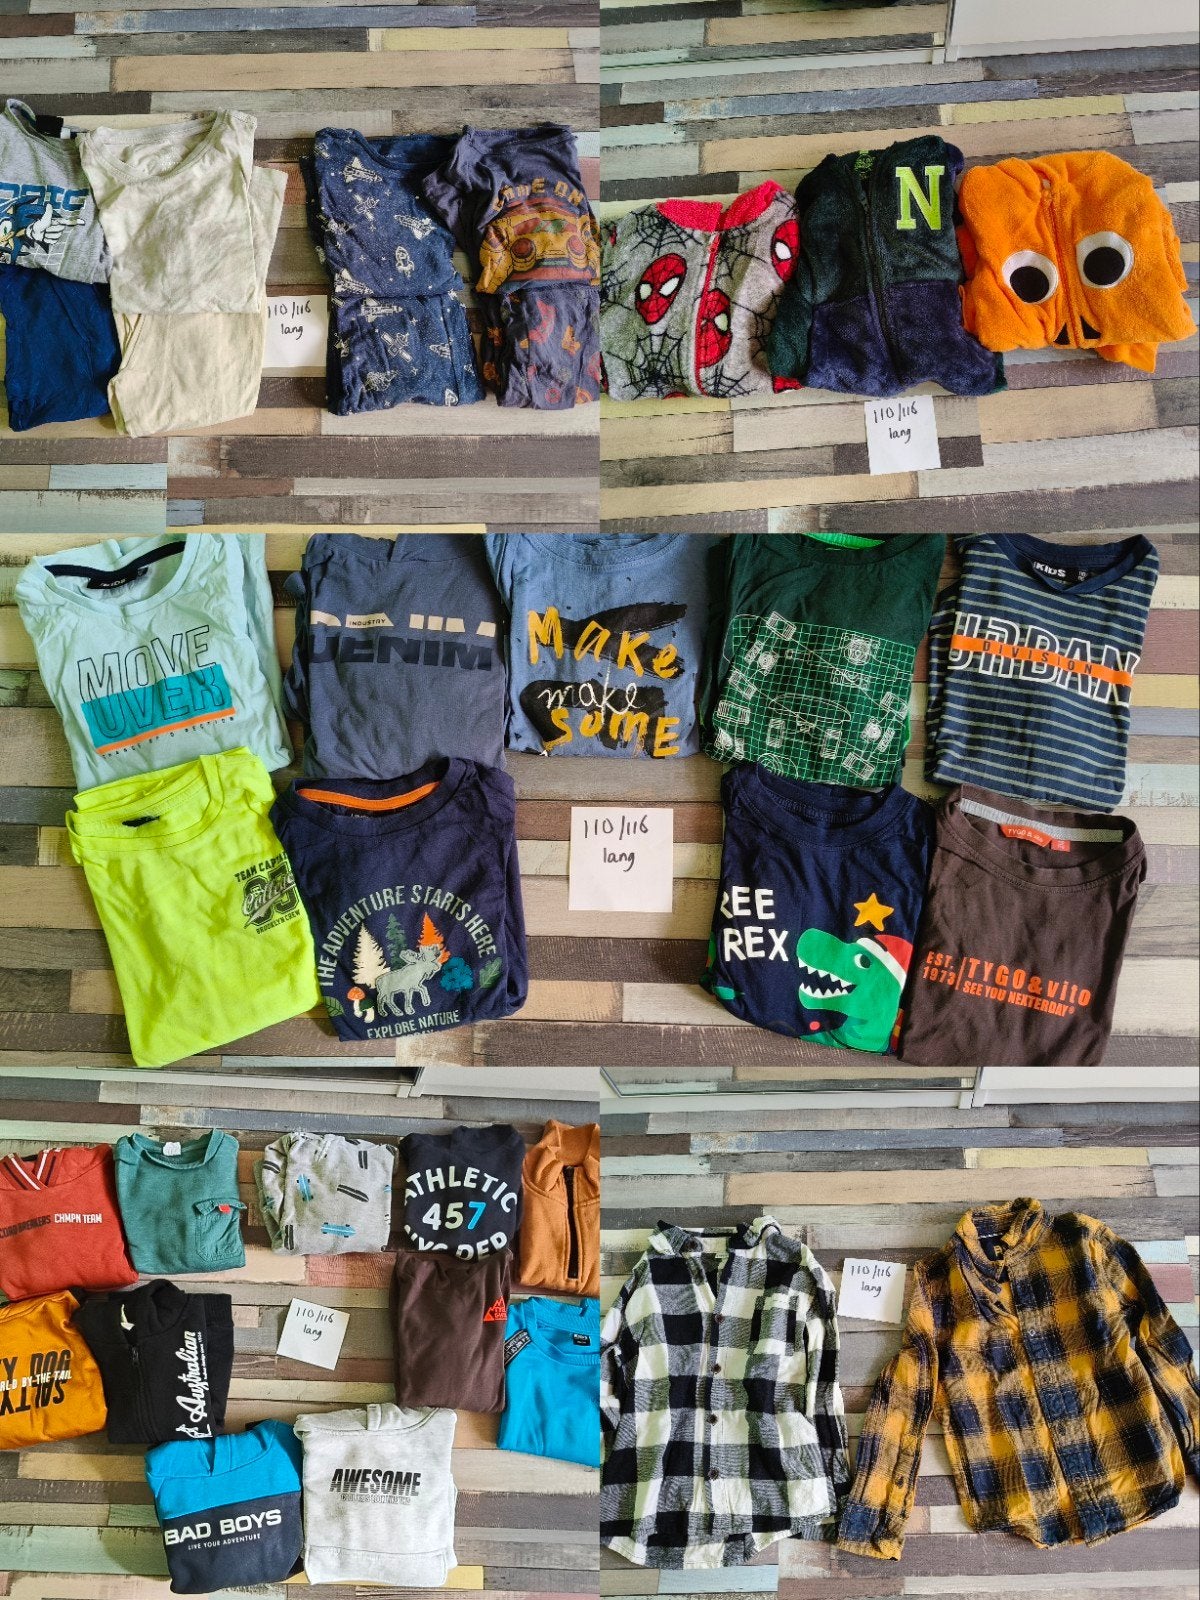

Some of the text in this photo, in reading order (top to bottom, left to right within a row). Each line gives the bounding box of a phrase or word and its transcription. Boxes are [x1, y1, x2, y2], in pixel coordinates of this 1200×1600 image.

[896, 165, 945, 230] N
[268, 300, 311, 318] 110/116
[281, 324, 303, 340] lang
[874, 401, 917, 423] 110/116
[889, 428, 911, 444] lang
[349, 618, 386, 626] INDUSTRY
[77, 625, 216, 703] MOVE
[983, 640, 1092, 675] DIVISION
[584, 815, 648, 840] 110/116
[603, 847, 635, 872] lang
[234, 865, 257, 882] TEAM
[410, 884, 472, 921] STARTS
[322, 885, 406, 956] ADVENTURE
[464, 914, 496, 957] HERE
[723, 926, 789, 961] REX
[926, 951, 954, 969] EST.
[318, 957, 337, 986] THE
[923, 966, 957, 986] 1973
[963, 981, 983, 996] SEE
[985, 986, 1006, 1001] YOU
[367, 1020, 417, 1038] EXPLORE
[419, 1010, 460, 1028] NATURE
[82, 1213, 102, 1224] TEAM
[422, 1201, 486, 1230] 457
[851, 1265, 891, 1279] 110/116
[861, 1281, 882, 1297] lang
[297, 1307, 335, 1323] 110/116
[304, 1324, 322, 1341] lang
[22, 1376, 33, 1387] BY
[36, 1372, 52, 1384] THE
[54, 1370, 72, 1380] TAIL
[175, 1330, 210, 1423] Australian
[329, 1468, 421, 1497] AWESOME
[164, 1509, 282, 1545] BAD BOYS
[203, 1538, 221, 1548] YOUR
[222, 1533, 261, 1545] ADVENTURE
